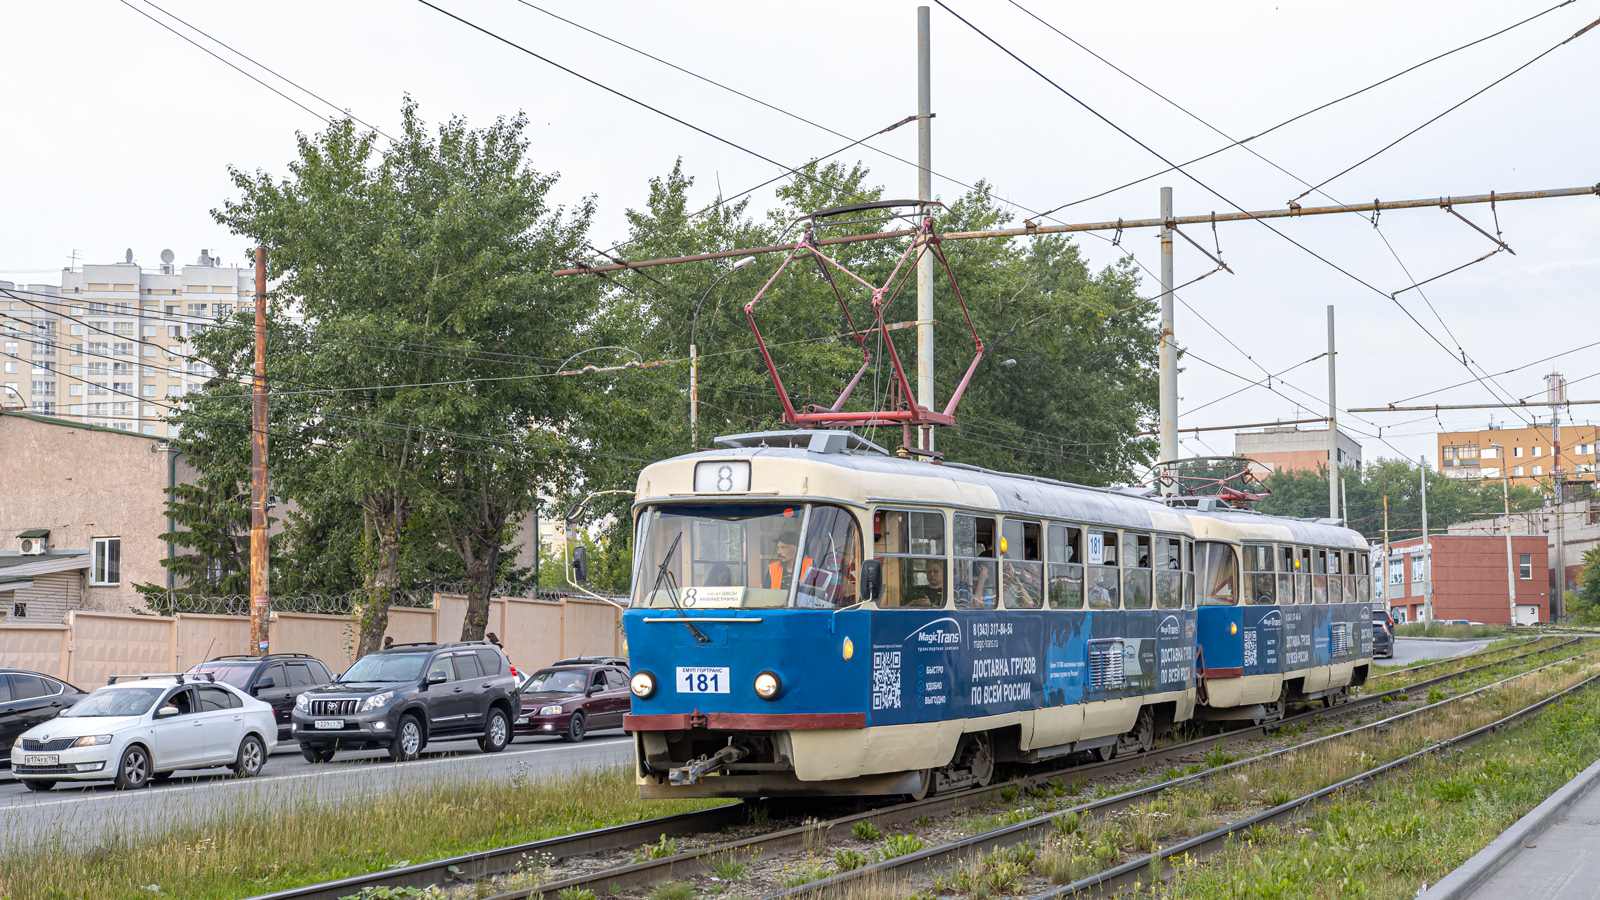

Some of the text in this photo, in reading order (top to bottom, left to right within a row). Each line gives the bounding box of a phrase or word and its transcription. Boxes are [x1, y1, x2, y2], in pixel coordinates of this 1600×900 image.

[716, 465, 733, 492] 8
[1090, 536, 1101, 555] 181
[682, 587, 698, 608] 8
[1530, 607, 1536, 615] 3
[917, 629, 960, 644] MagicTrans
[972, 623, 977, 636] 8
[977, 623, 990, 638] (343)
[926, 666, 944, 675] БЫСТРО
[971, 656, 1037, 682] ДОСТАВКА ГРУЗОВ
[685, 673, 719, 692] 181
[925, 681, 943, 691] УДОБНО
[924, 695, 947, 705] ВЫГОДНО
[971, 680, 1031, 706] ПО ВСЕЙ РОССИИ
